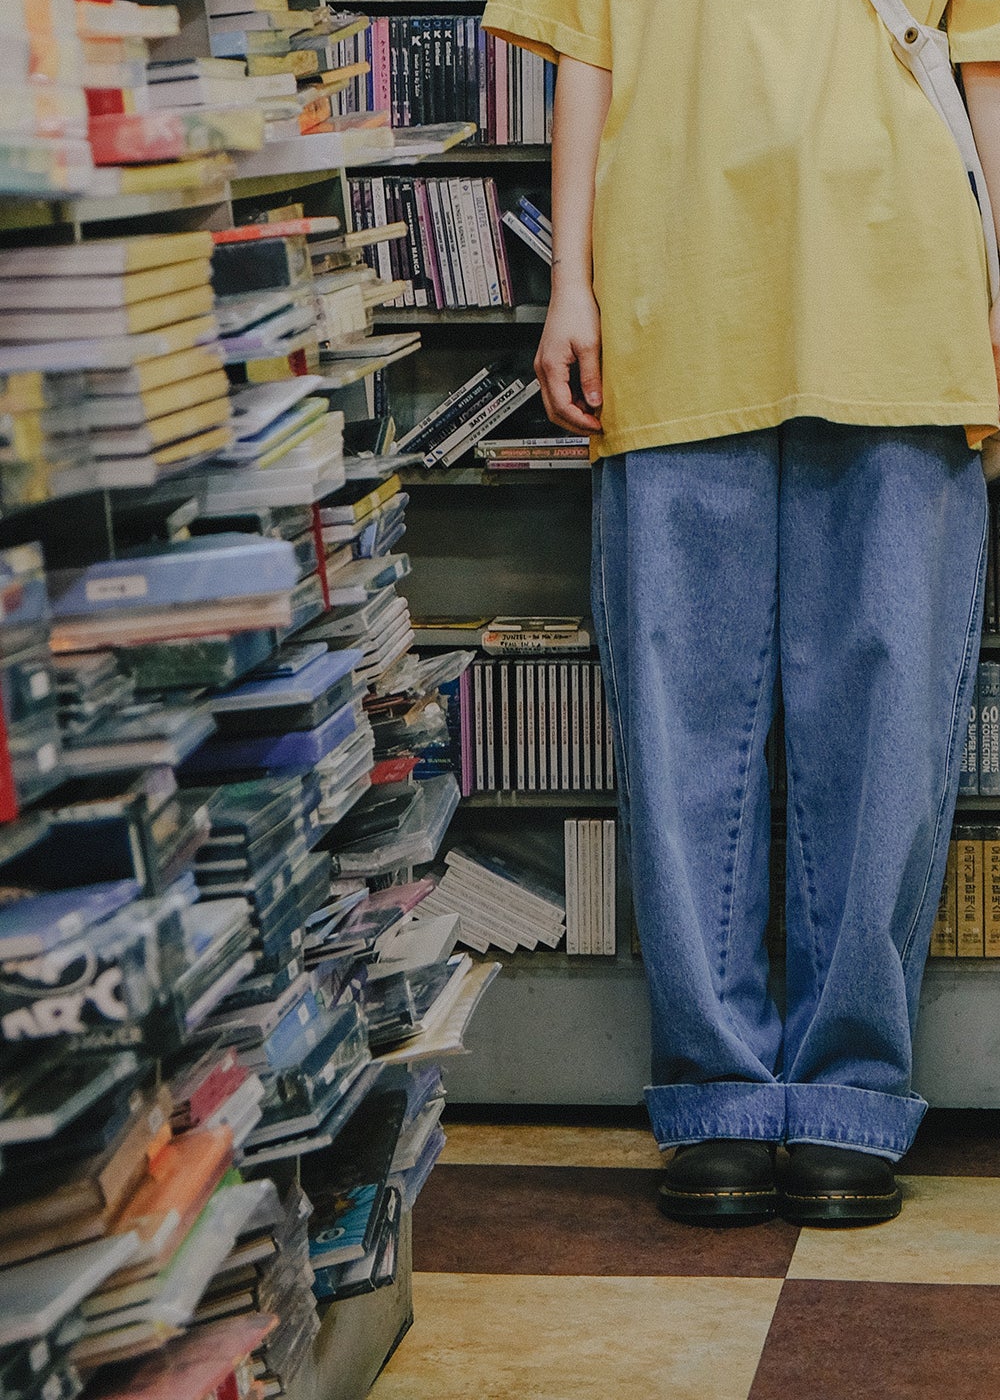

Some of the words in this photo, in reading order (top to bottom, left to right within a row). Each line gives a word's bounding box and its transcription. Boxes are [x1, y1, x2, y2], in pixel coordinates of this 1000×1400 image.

[411, 35, 421, 46] K
[423, 31, 431, 40] K
[434, 30, 441, 38] K
[444, 30, 452, 38] K
[454, 203, 463, 224] SINGER
[457, 225, 466, 249] SONGER
[411, 247, 421, 275] MANGA
[468, 412, 488, 430] ALIVE
[982, 705, 999, 722] 60
[991, 724, 999, 752] SUPER
[982, 724, 990, 773] COLLECTION
[991, 753, 999, 773] HITS
